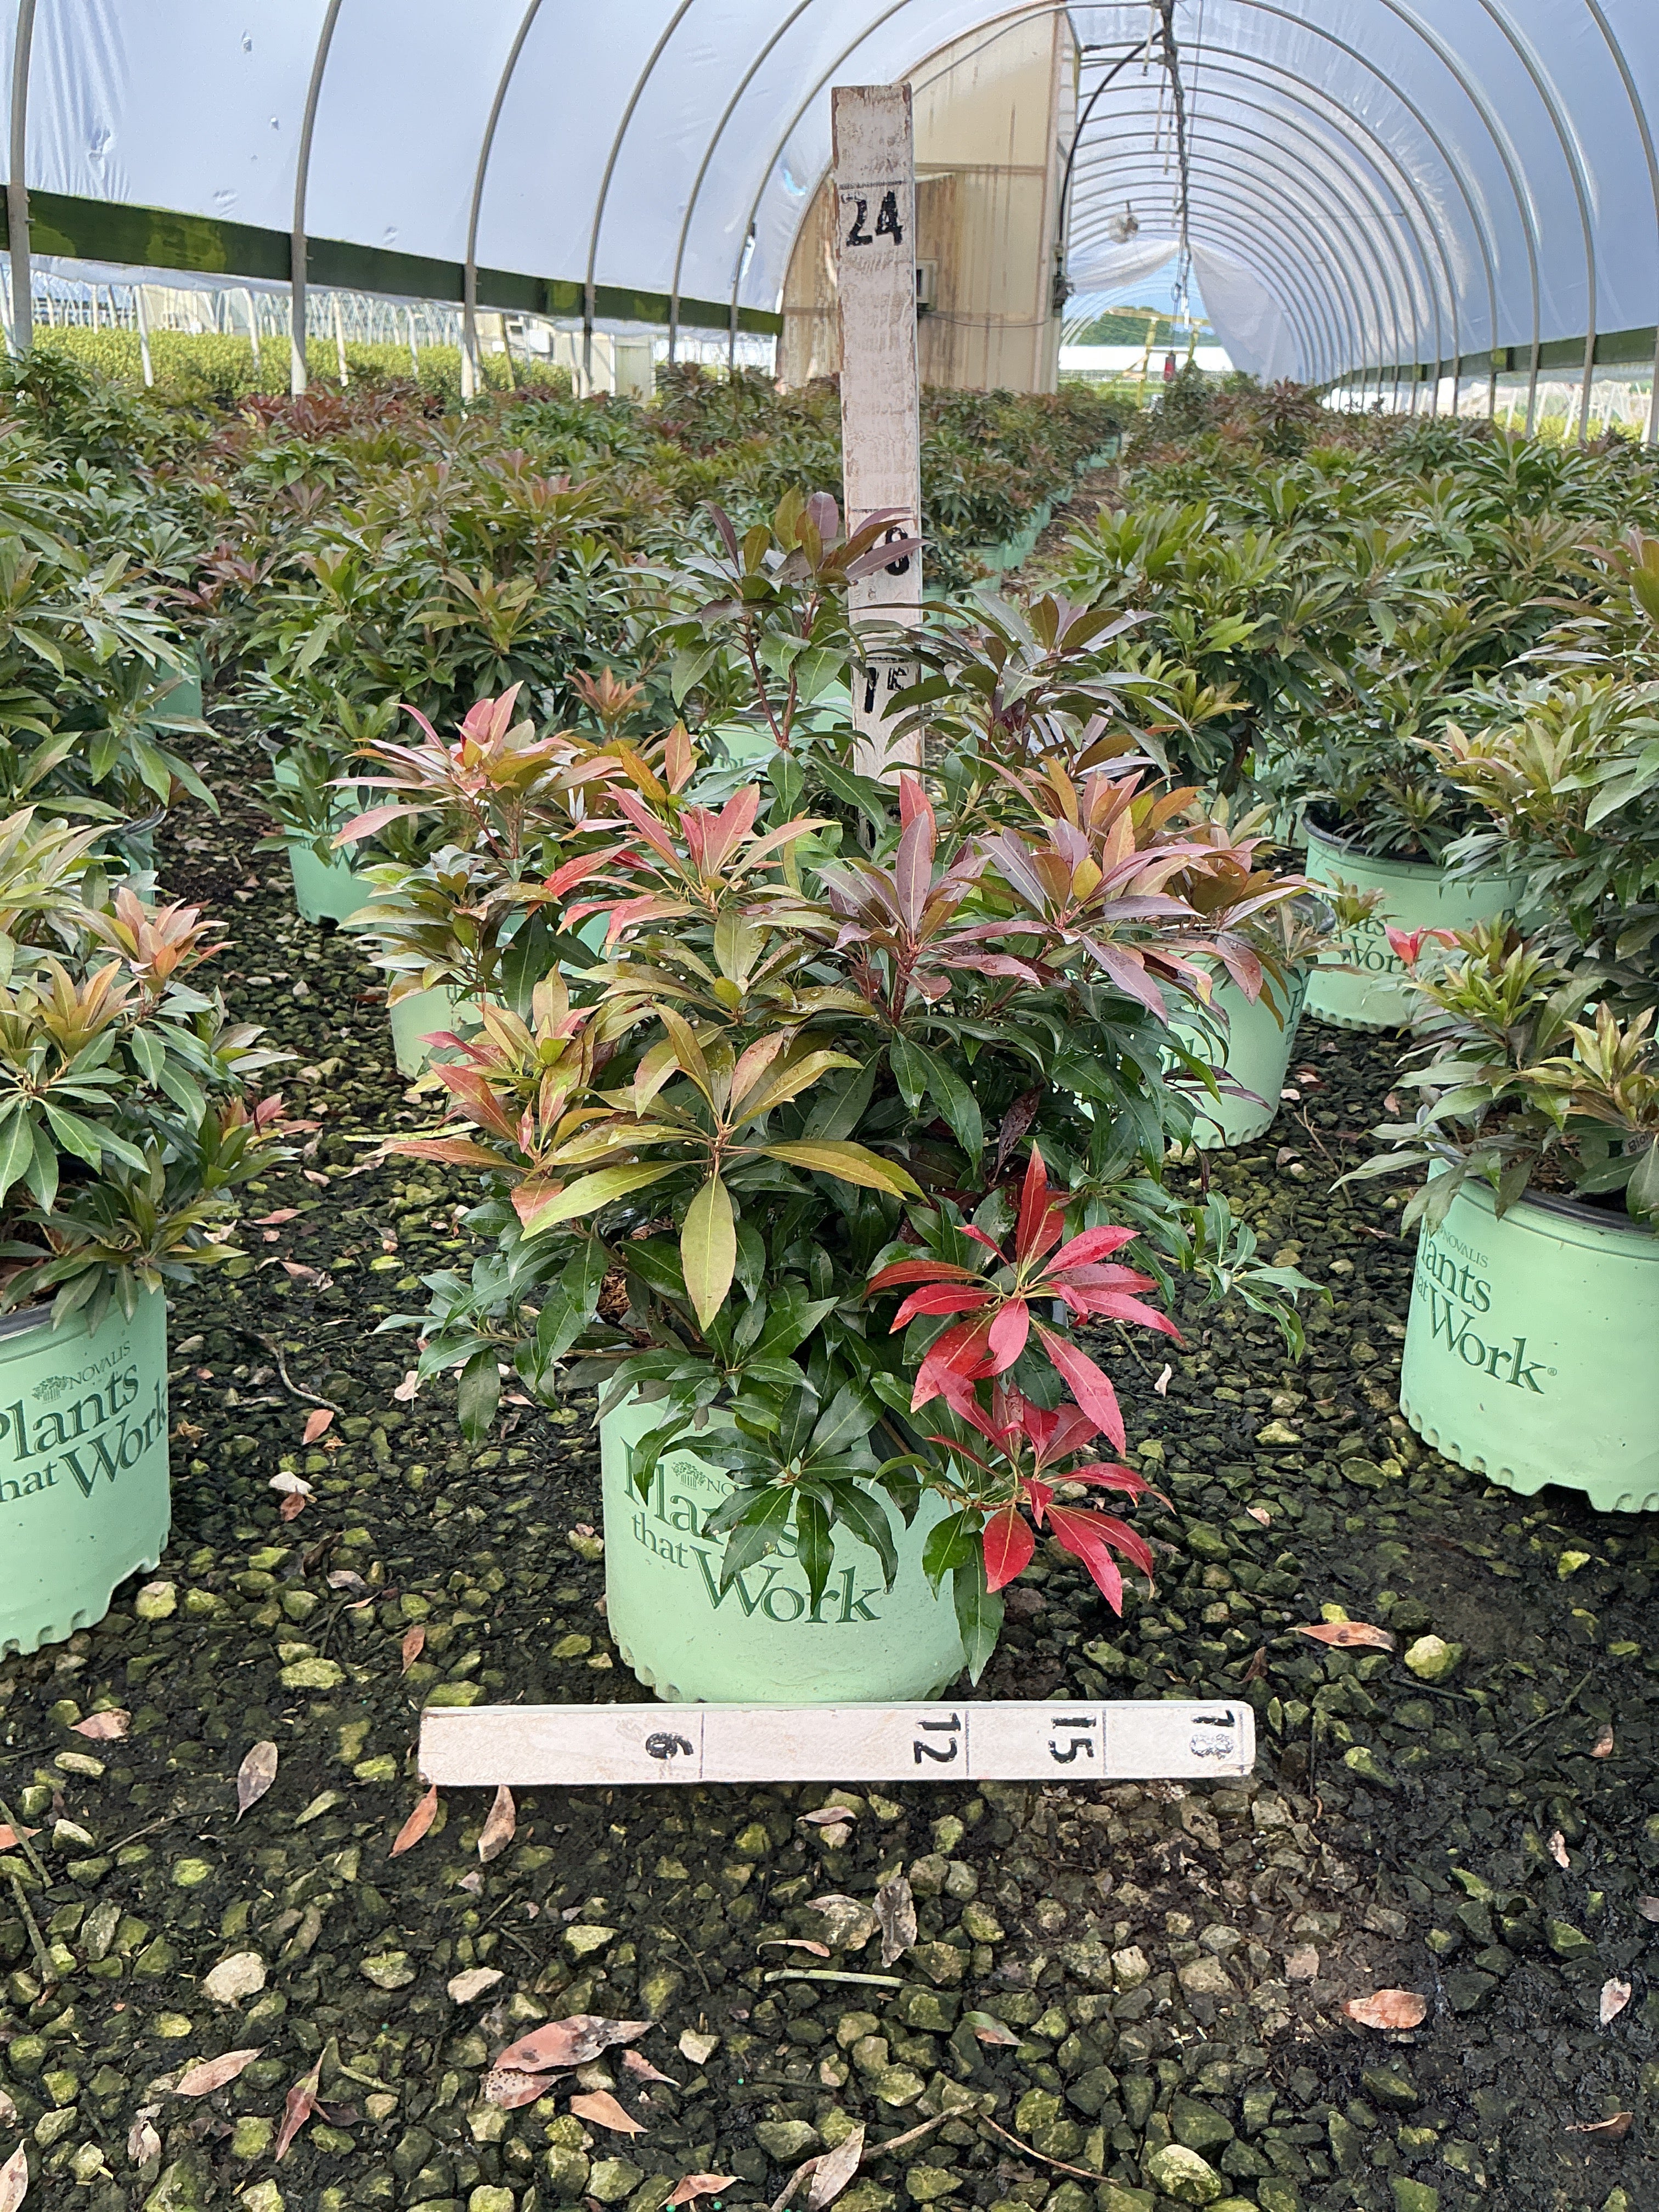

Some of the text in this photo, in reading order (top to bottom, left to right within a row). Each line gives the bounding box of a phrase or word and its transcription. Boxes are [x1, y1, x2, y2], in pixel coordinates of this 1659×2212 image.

[840, 190, 903, 246] 24
[1442, 1229, 1488, 1268] NOVALIS
[68, 1340, 131, 1390] NOVALIS
[0, 1459, 59, 1503] hat
[631, 1511, 688, 1569] that
[645, 1732, 693, 1760] 6
[913, 1712, 961, 1764] 12
[1048, 1716, 1097, 1764] 15
[1189, 1709, 1235, 1760] 18
